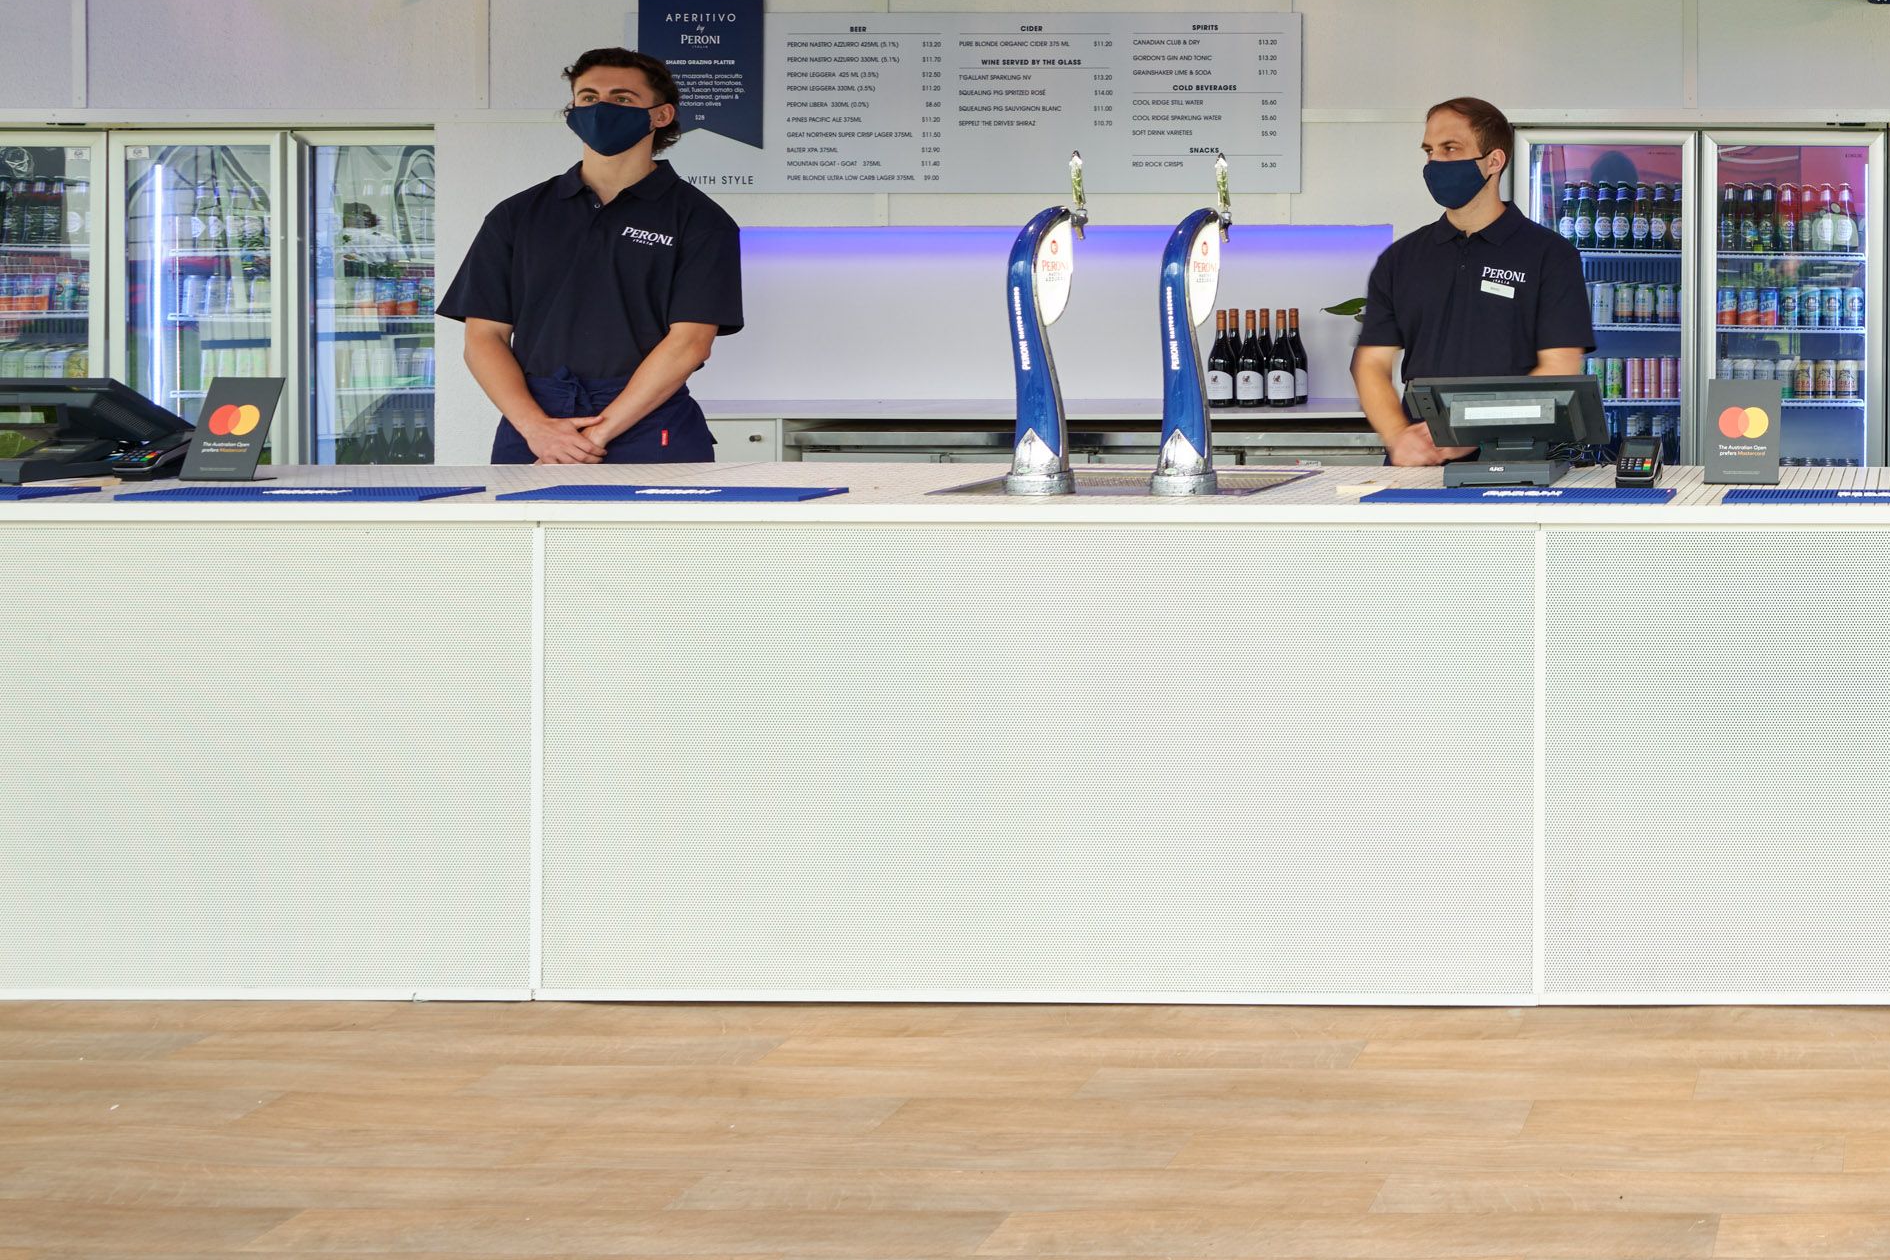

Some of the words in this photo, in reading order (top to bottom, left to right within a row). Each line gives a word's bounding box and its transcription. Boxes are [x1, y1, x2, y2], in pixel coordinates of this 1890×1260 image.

[666, 14, 736, 22] APERITIVO
[696, 24, 705, 34] by
[681, 35, 720, 45] PERONI
[722, 176, 753, 184] STYLE
[621, 226, 674, 247] PERONI
[1481, 266, 1526, 283] PERONI
[1019, 340, 1031, 371] PERONI
[1169, 340, 1180, 370] PERONI
